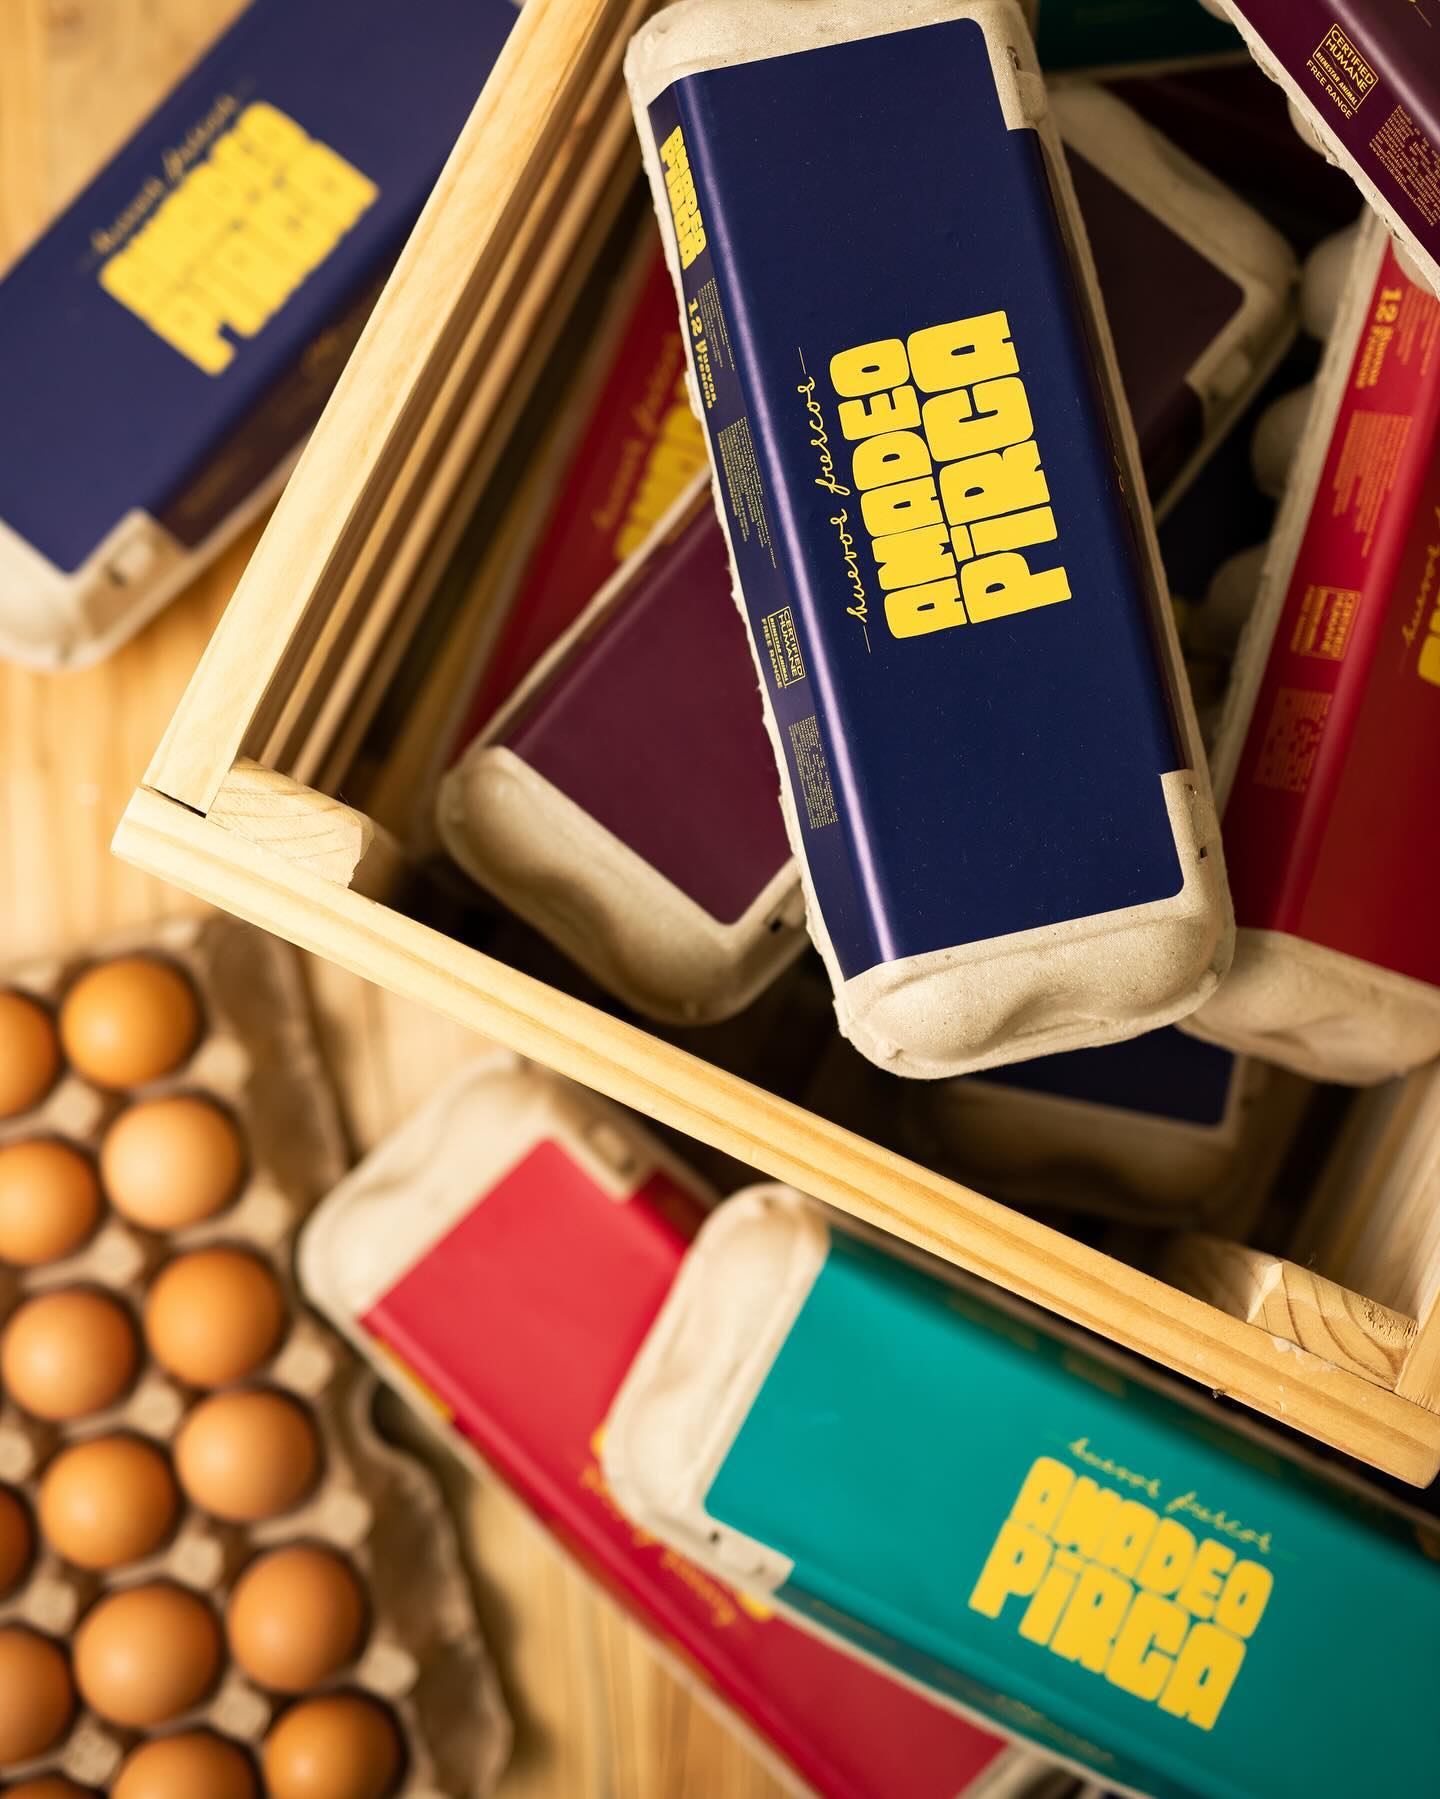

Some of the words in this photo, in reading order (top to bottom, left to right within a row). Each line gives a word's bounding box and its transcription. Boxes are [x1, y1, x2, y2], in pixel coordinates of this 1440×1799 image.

[1307, 59, 1325, 86] FREE
[1325, 85, 1352, 118] RANGE
[1314, 51, 1340, 84] BIENESTAR
[1339, 82, 1359, 105] ANIMAL
[1325, 37, 1368, 93] HUMANE
[1331, 29, 1374, 86] CERTIFIED
[688, 298, 703, 336] 12
[797, 376, 850, 496] frescos
[830, 339, 967, 638] AMADEO
[830, 510, 867, 622] huevos
[762, 618, 773, 647] FREE
[770, 648, 782, 688] RANGE
[779, 615, 798, 676] HUMANE
[783, 609, 804, 676] CERTIFIED
[1007, 1456, 1274, 1640] AMADEO
